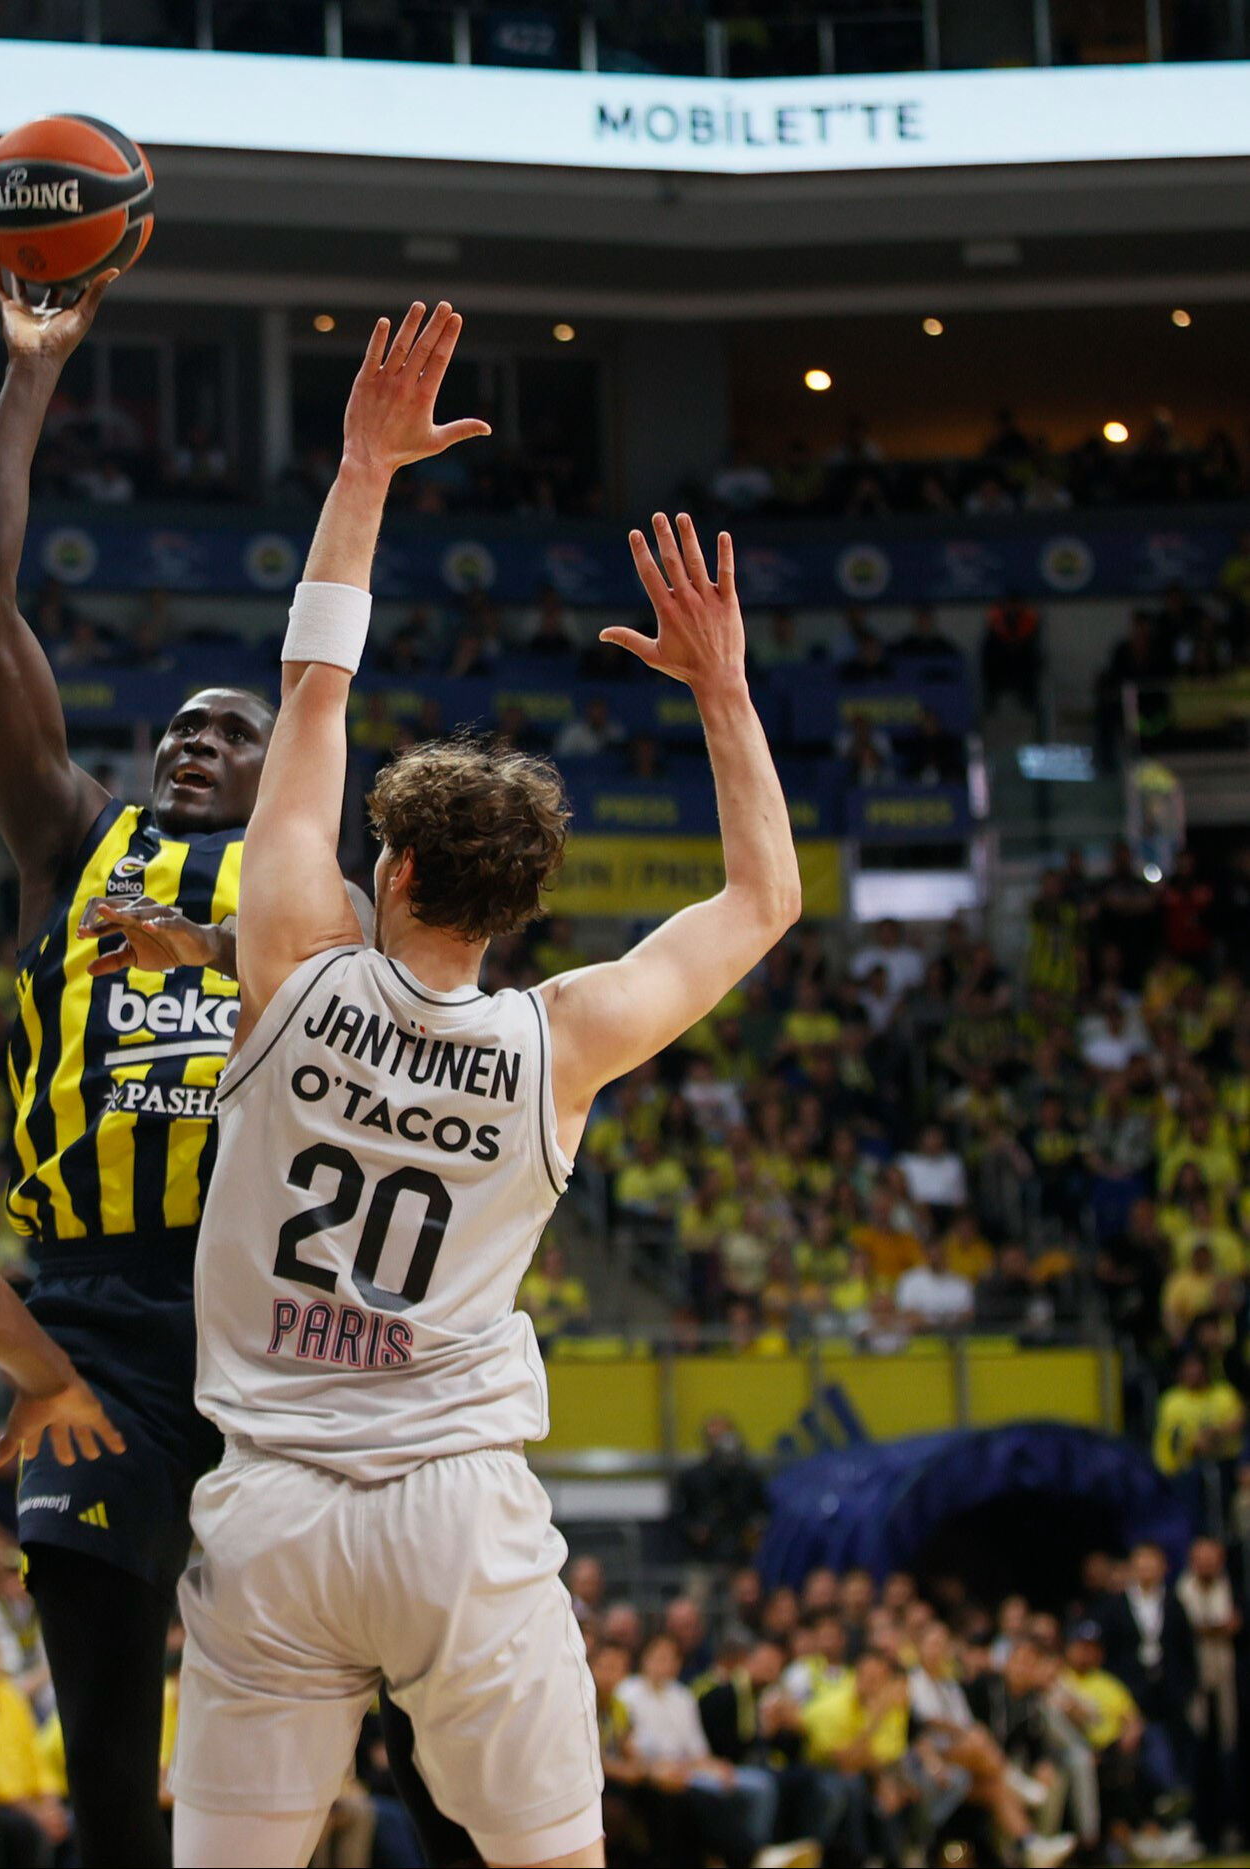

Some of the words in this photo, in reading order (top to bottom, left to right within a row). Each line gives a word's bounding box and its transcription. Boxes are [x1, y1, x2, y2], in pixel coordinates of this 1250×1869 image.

[107, 879, 143, 893] beko
[107, 983, 241, 1038] beko
[291, 1065, 501, 1162] O'TACOS
[273, 1142, 453, 1314] 20
[267, 1298, 414, 1368] PARIS
